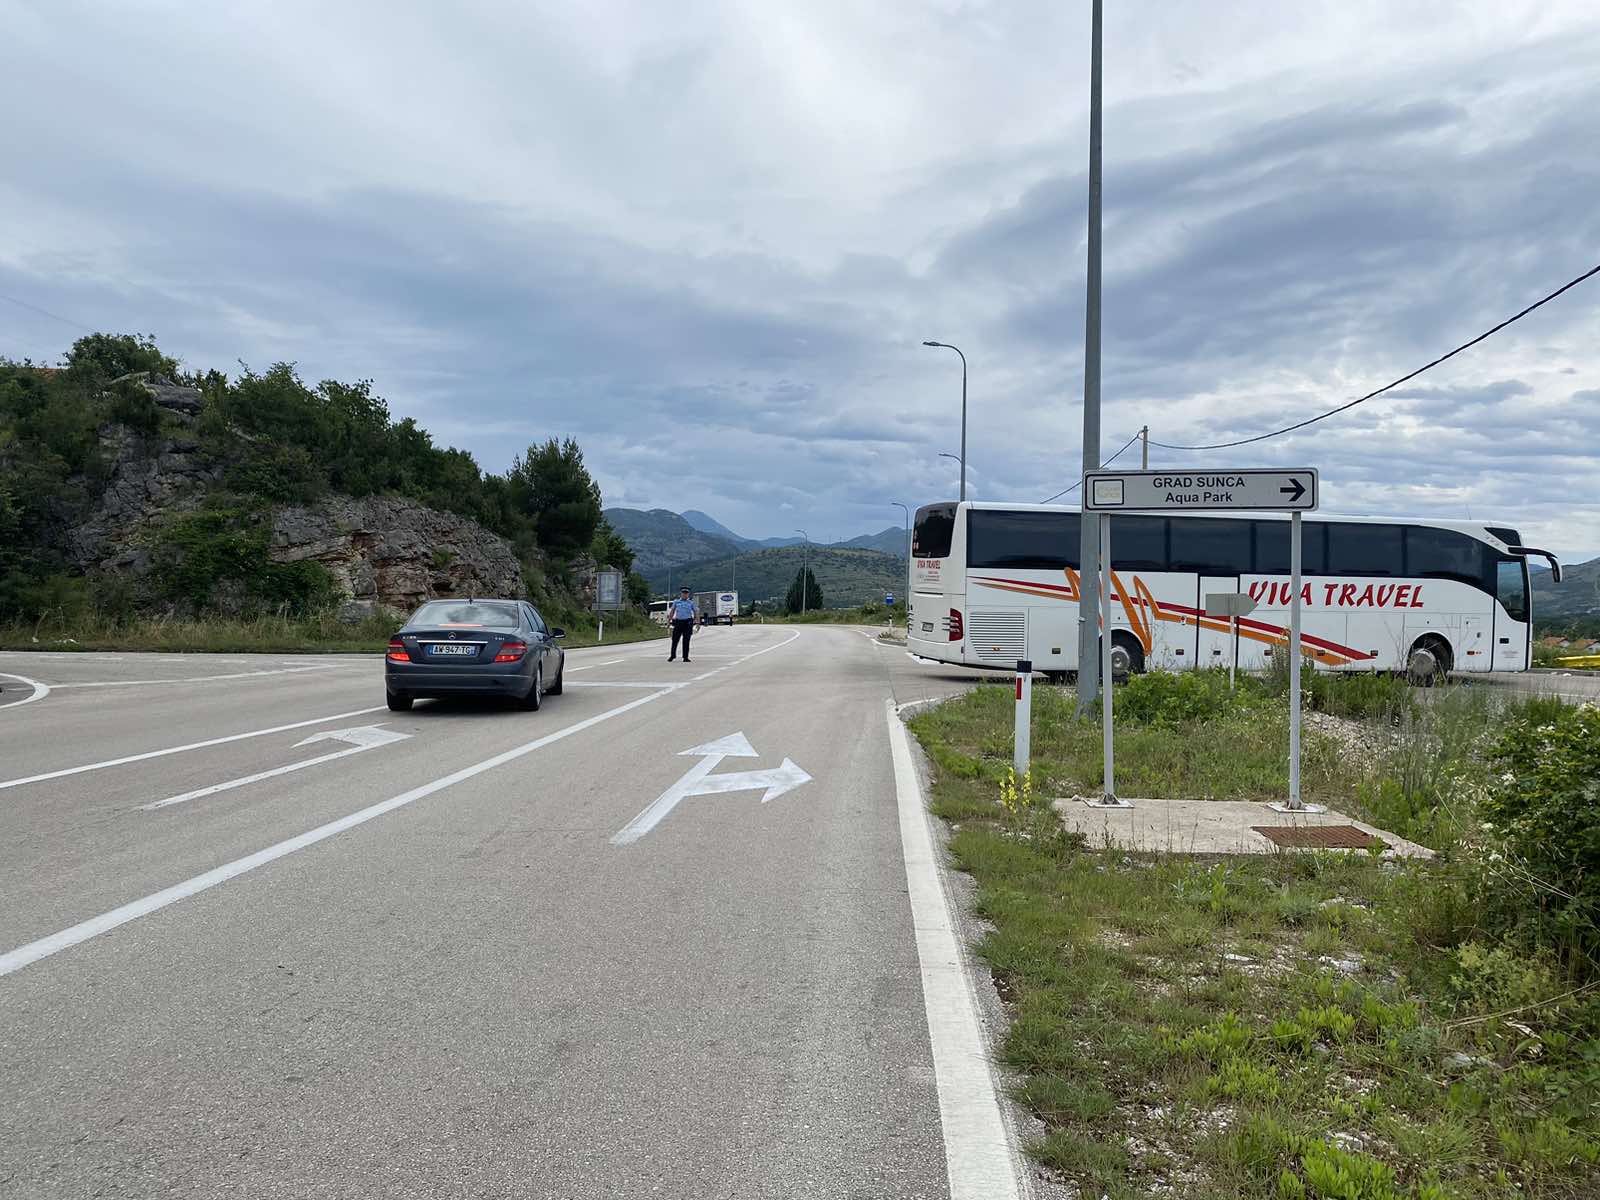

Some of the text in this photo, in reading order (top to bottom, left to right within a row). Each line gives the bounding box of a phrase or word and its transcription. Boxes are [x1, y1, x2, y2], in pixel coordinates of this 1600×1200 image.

[1153, 477, 1245, 488] GRAD SUNCA
[1165, 491, 1233, 504] Aqua Park
[1248, 580, 1424, 608] VIVA TRAVEL
